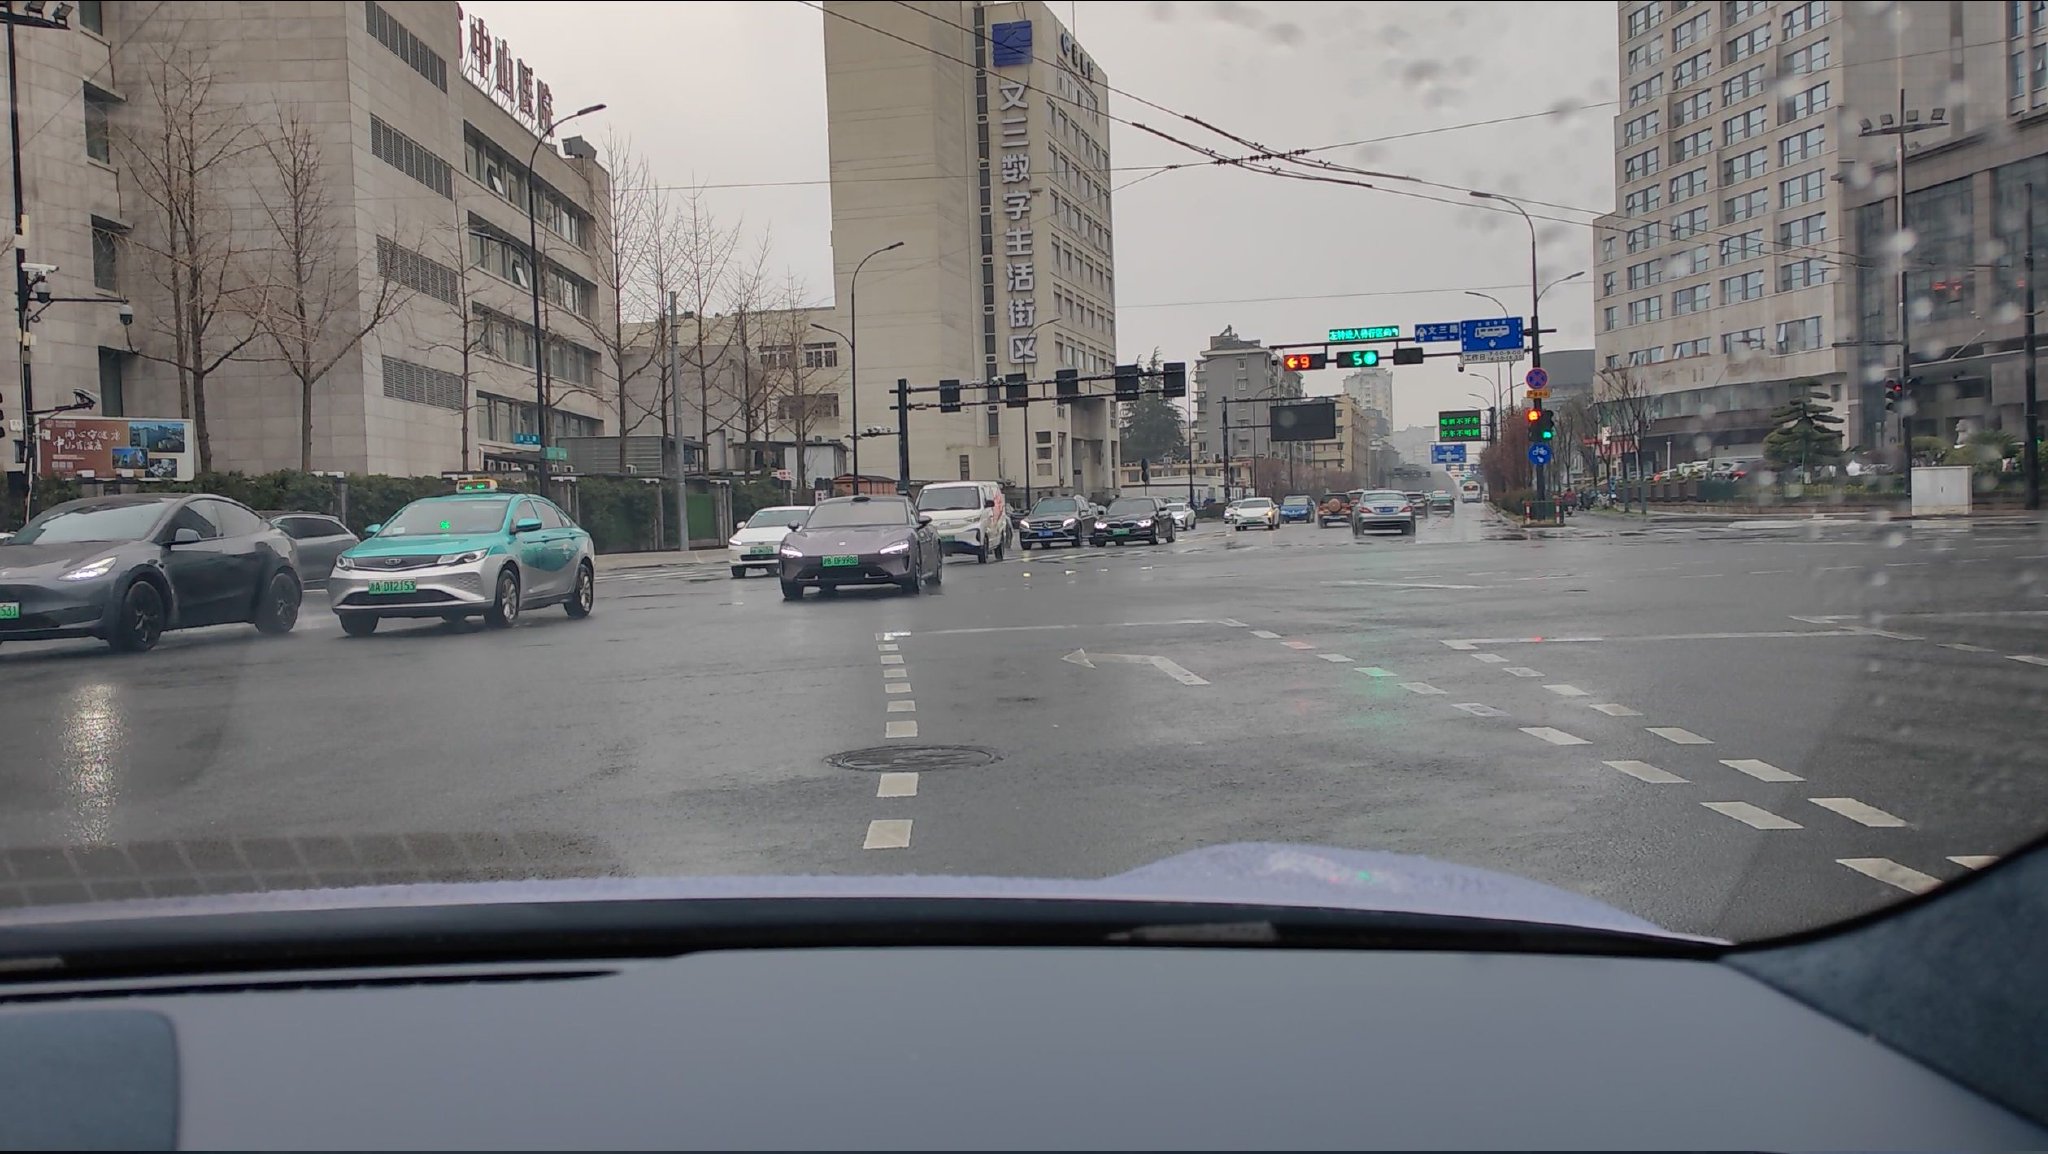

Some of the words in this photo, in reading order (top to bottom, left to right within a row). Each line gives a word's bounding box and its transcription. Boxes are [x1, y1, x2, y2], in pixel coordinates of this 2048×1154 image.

[457, 2, 554, 138] 中山医院
[1300, 356, 1310, 369] 9
[1352, 352, 1363, 366] 5
[1464, 353, 1486, 362] 工作日
